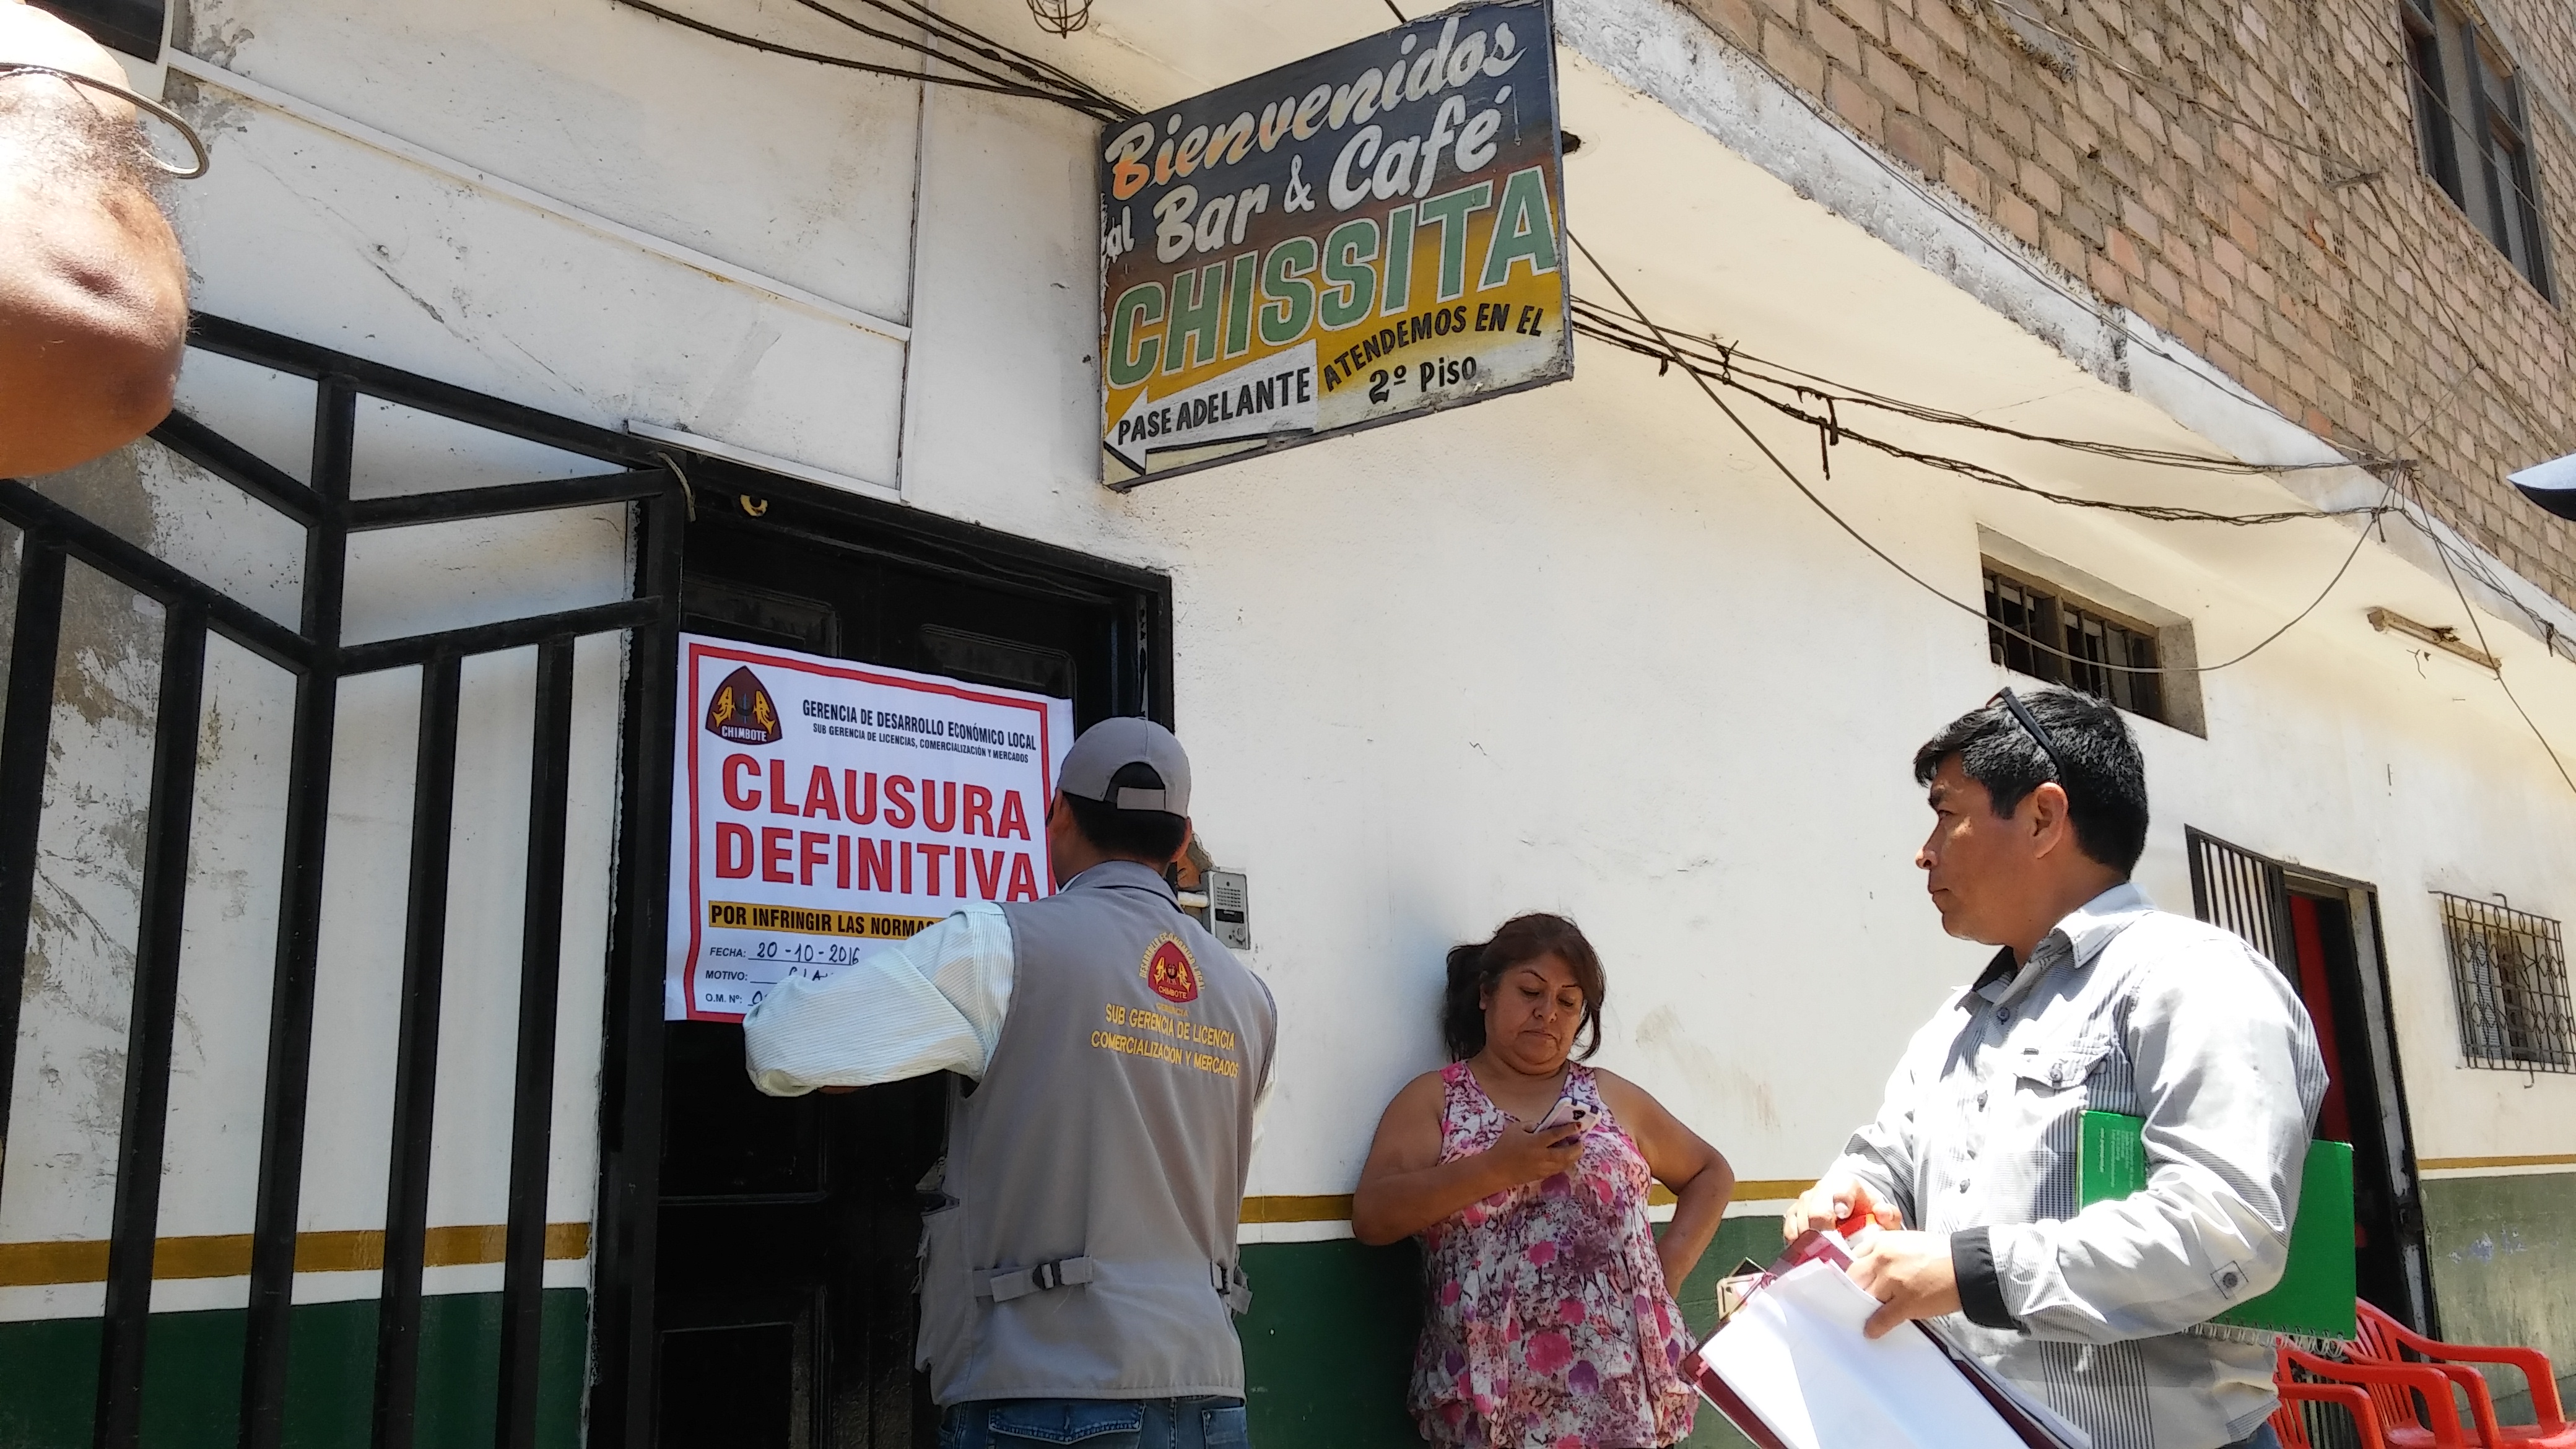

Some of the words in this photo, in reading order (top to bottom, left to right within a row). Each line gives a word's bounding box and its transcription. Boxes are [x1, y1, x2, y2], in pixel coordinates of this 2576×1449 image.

[1105, 16, 1528, 201] Bienvenidos
[1153, 183, 1271, 264] Bar
[1284, 154, 1315, 214] &
[1327, 84, 1513, 212] Café
[1107, 165, 1559, 390] CHISSITA
[1323, 306, 1468, 392] ATENDEMOS
[1475, 303, 1510, 332] EN
[1516, 305, 1544, 337] EL
[1118, 407, 1172, 445] PASE
[1176, 367, 1310, 432] ADELANTE
[721, 725, 767, 742] CHIMBOTE
[803, 698, 857, 723] GERENCIA
[860, 708, 873, 726] DE
[877, 711, 944, 736] DESARROLLO
[948, 721, 1004, 746] ECONÓMICO
[1007, 731, 1037, 751] LOCAL
[813, 723, 827, 734] SUB
[829, 725, 865, 740] GERENCIA
[867, 731, 877, 742] DE
[879, 733, 918, 749] LICENCIAS,
[920, 738, 986, 757] COMERCIALIZACIÓN
[988, 749, 992, 758] Y
[993, 749, 1029, 764] MERCADOS
[722, 753, 1031, 842] CLAUSURA
[715, 821, 1039, 902] DEFINITIVA
[711, 905, 746, 926] POR
[753, 908, 832, 932] INFRINGIR
[838, 915, 865, 934] LAS
[705, 970, 748, 981] MOTIVO:
[710, 946, 746, 958] FECHA:
[705, 993, 726, 1003] O.M.
[1158, 985, 1188, 999] CHIMBOTE
[1193, 965, 1206, 991] LOCAL
[1105, 1003, 1126, 1025] SUB
[1129, 1008, 1175, 1038] GERENCIA
[1177, 1021, 1191, 1040] DE
[1193, 1024, 1235, 1051] LICENCIA
[1155, 1002, 1189, 1017] GERENCIA
[1090, 1030, 1183, 1065] COMERCIALIZACION
[1185, 1050, 1193, 1067] Y
[1193, 1051, 1239, 1079] MERCADOS
